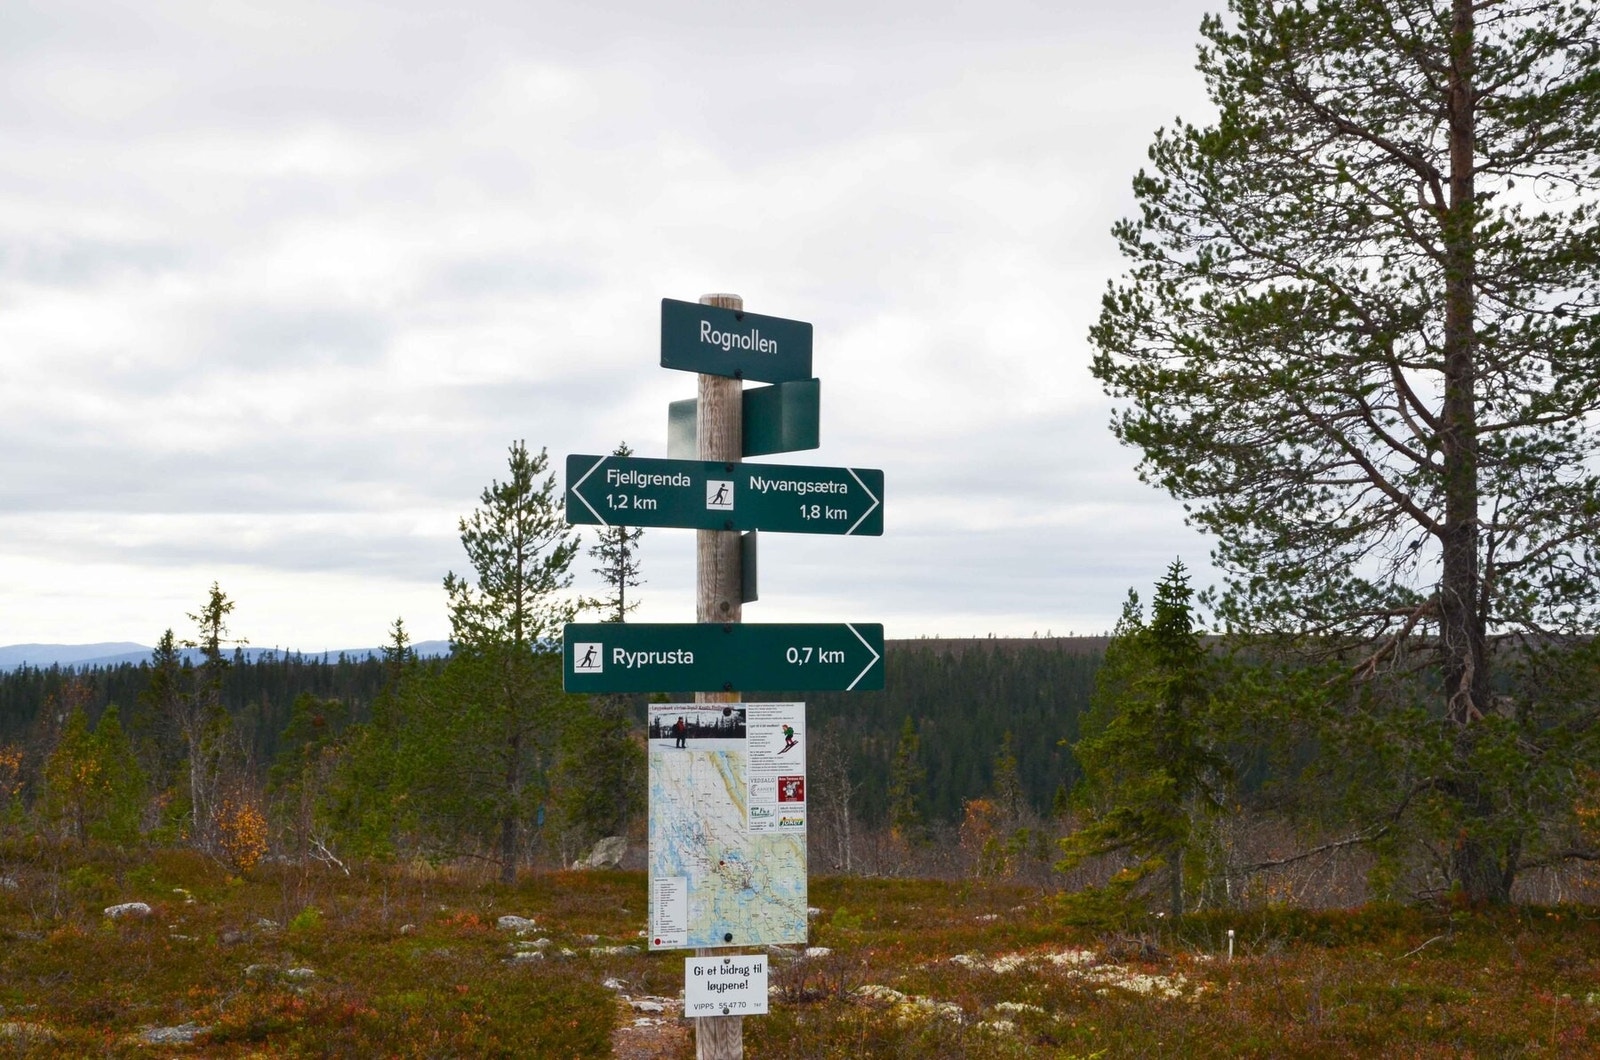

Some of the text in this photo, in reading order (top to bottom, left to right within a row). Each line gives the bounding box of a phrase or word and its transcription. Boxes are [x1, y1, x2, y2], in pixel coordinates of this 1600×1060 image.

[700, 320, 778, 354] Rognollen
[607, 469, 690, 488] Fjellgrenda
[749, 476, 847, 496] Nyvangsætra
[606, 494, 657, 511] 1,2 km
[799, 504, 848, 520] 1,8 km
[613, 647, 845, 668] Ryprusta 0,7 km
[693, 963, 762, 977] Gi et bidrag til
[707, 980, 748, 994] løypene!
